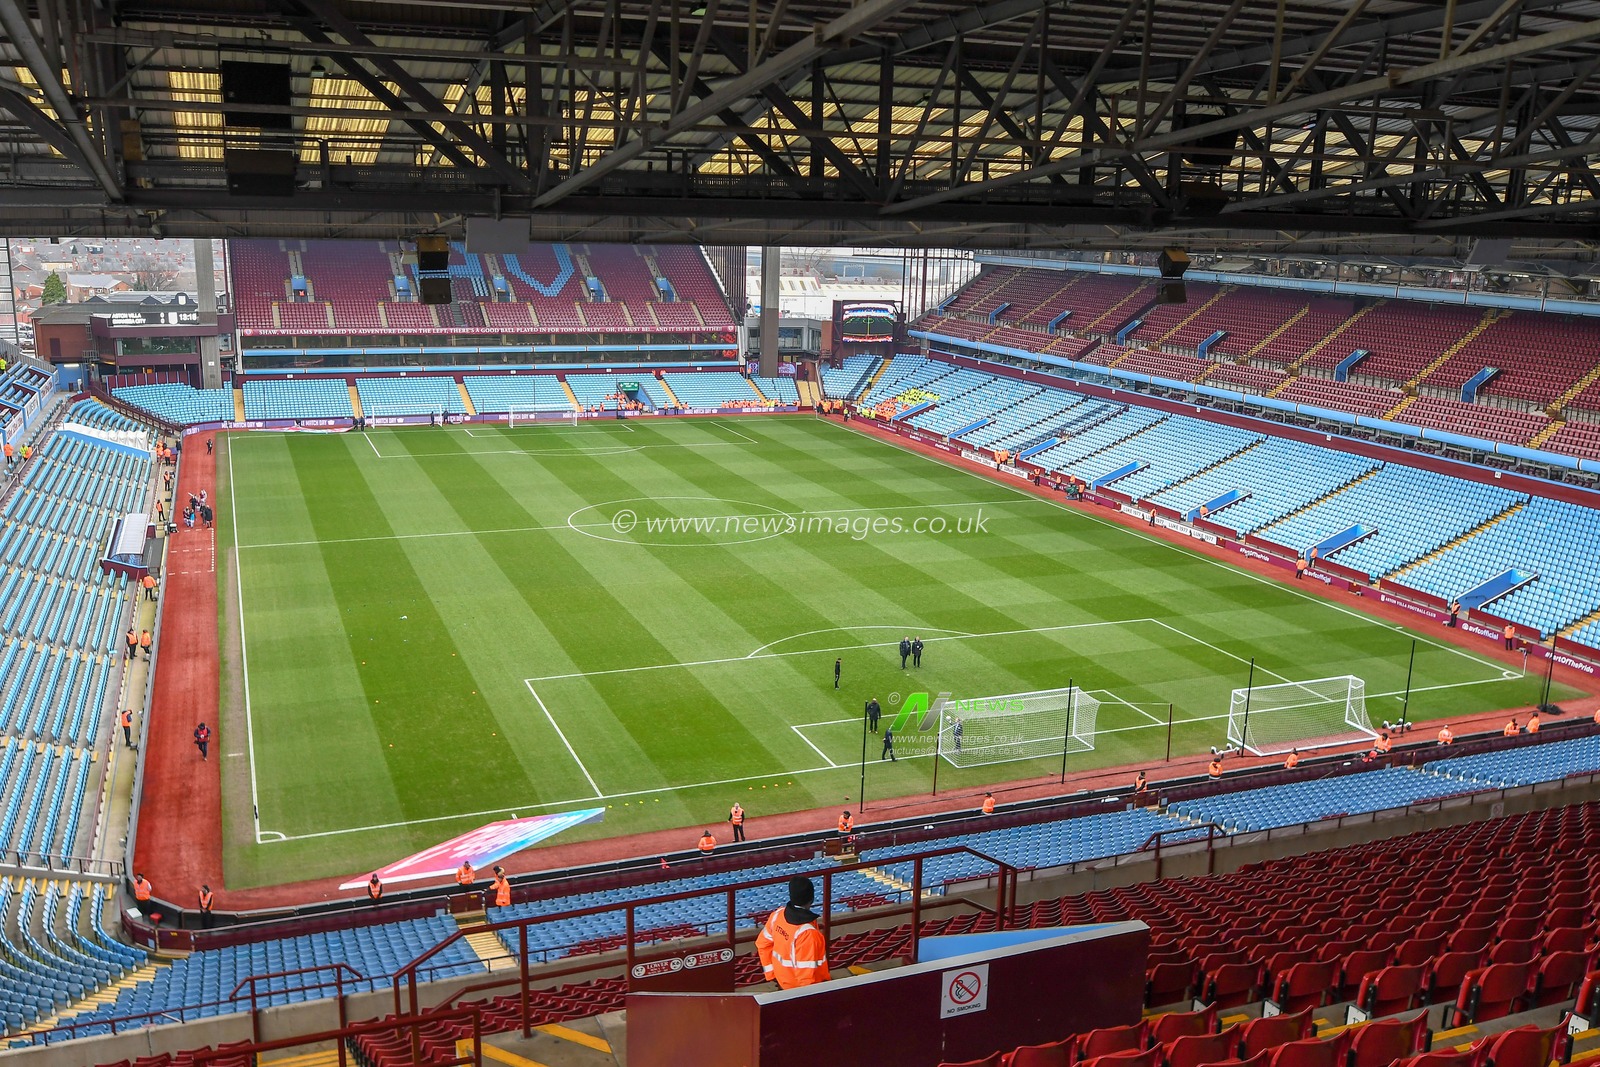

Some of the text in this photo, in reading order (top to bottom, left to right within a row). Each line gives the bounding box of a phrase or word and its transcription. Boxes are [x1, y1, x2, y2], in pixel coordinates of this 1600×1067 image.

[699, 952, 718, 960] UPPER
[646, 961, 669, 970] LOWER
[957, 1002, 981, 1012] SMOKING
